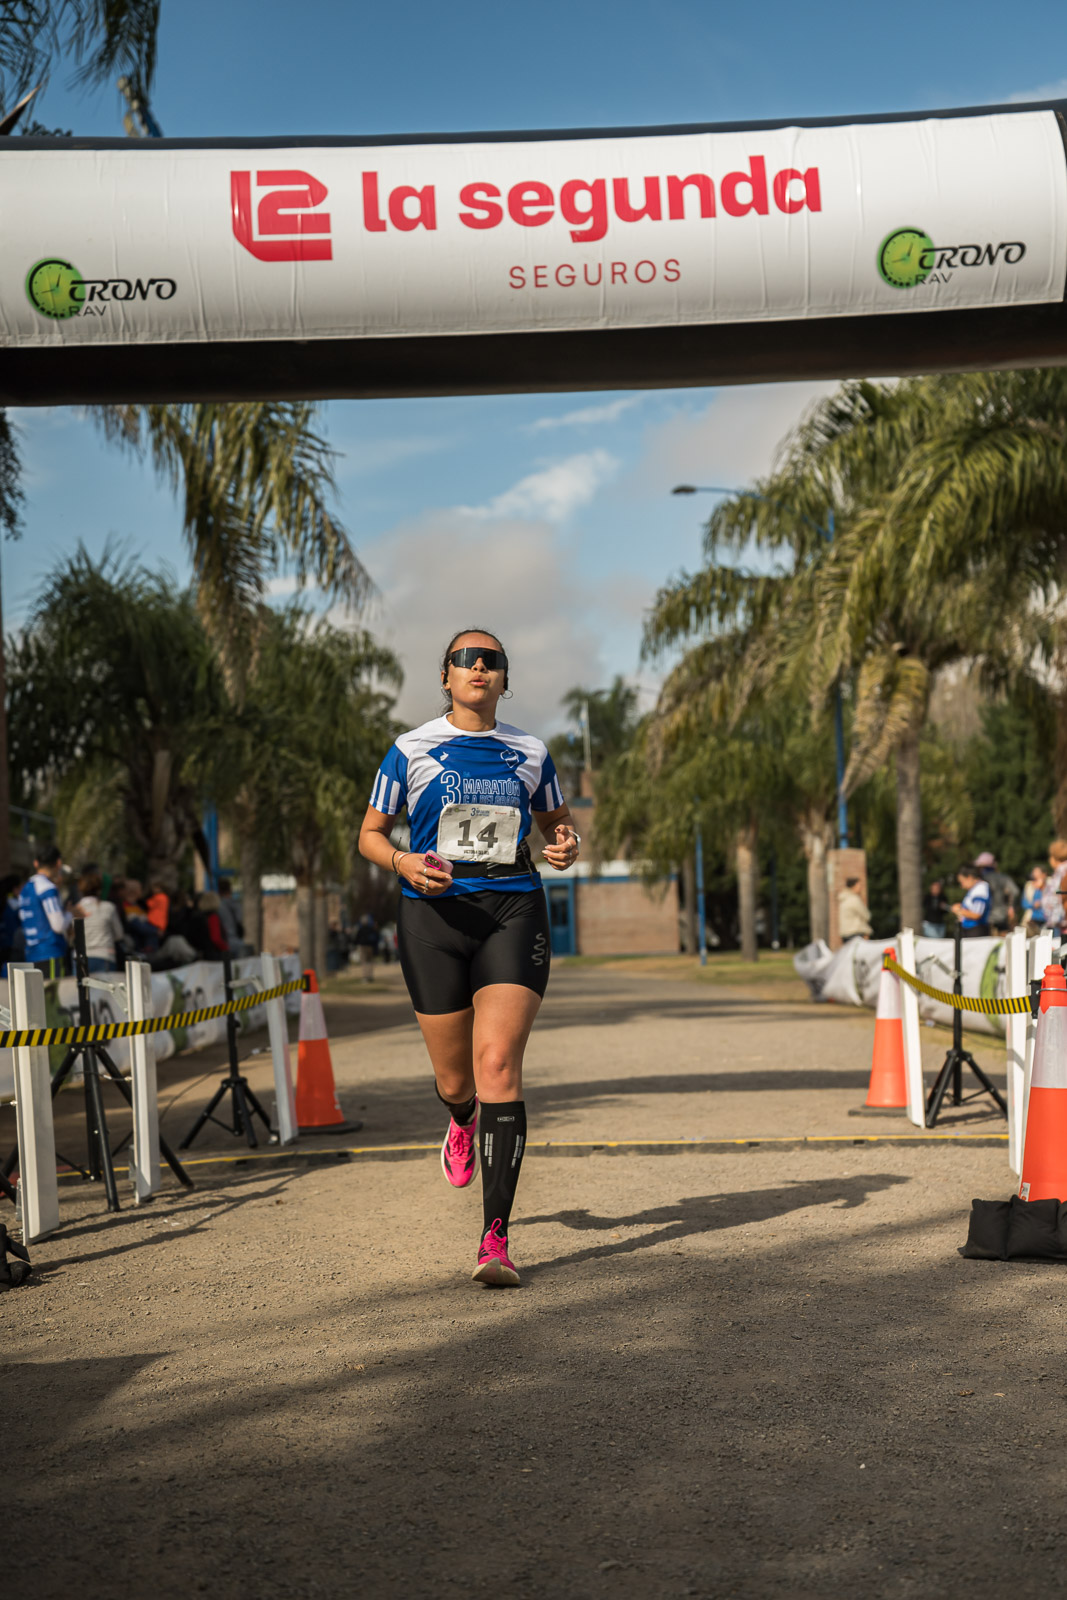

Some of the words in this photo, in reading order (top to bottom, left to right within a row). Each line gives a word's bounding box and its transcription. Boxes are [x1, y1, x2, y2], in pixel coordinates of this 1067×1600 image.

[361, 171, 437, 232] la
[458, 155, 822, 243] segunda
[918, 242, 1026, 270] CRONO
[509, 258, 681, 289] SEGUROS
[915, 271, 953, 285] RAV
[69, 278, 177, 301] CRONO
[68, 305, 106, 317] RAV
[440, 770, 462, 806] 3
[463, 778, 521, 796] MARATÓN
[457, 819, 498, 848] 14
